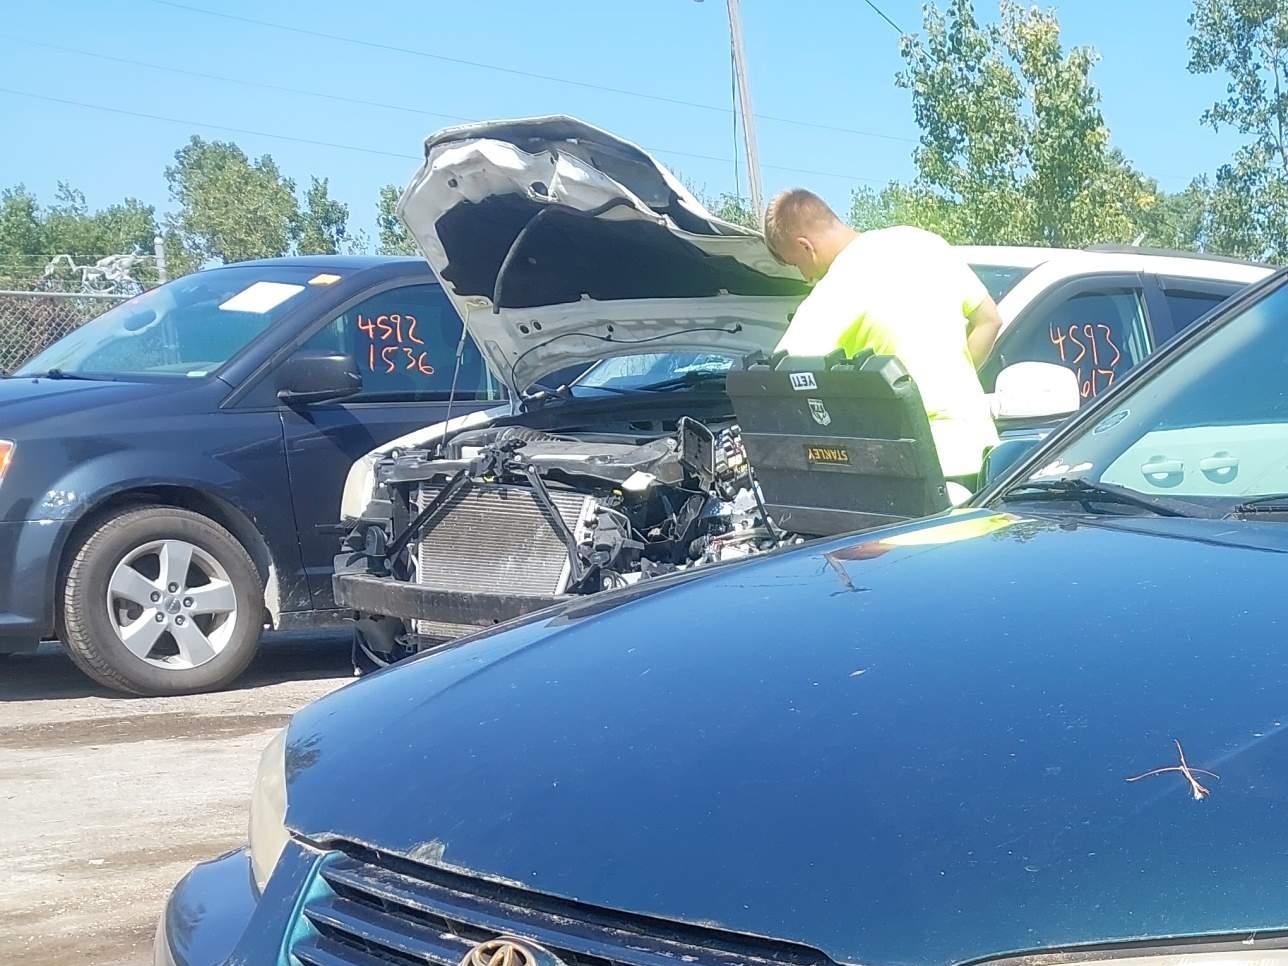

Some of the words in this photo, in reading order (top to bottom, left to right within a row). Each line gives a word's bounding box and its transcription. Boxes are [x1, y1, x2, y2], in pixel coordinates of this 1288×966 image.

[356, 313, 425, 346] 4592
[1049, 321, 1121, 367] 4593
[368, 343, 435, 376] 1536
[791, 374, 816, 389] YETI
[807, 448, 849, 462] STANLEY
